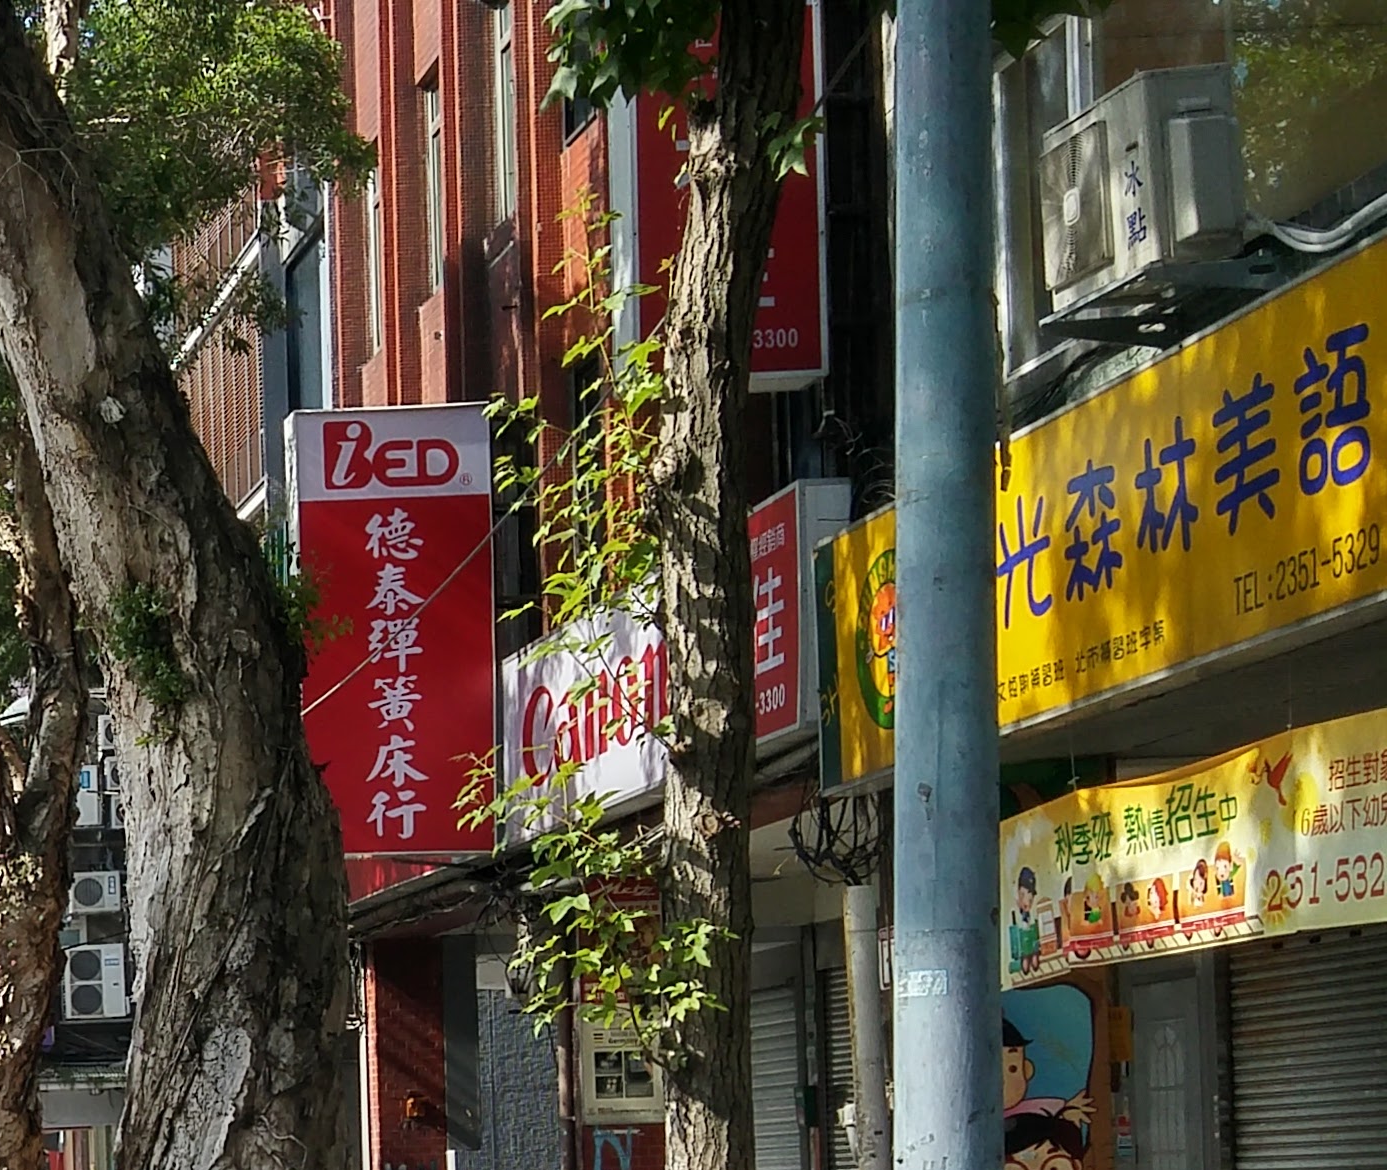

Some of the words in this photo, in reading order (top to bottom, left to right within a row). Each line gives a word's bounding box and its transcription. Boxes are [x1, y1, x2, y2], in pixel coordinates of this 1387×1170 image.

[365, 507, 430, 840] 德泰彈簧床行
[522, 639, 670, 788] Canon
[1054, 811, 1114, 874] 秋季班
[1124, 783, 1238, 856] 熱情招生中
